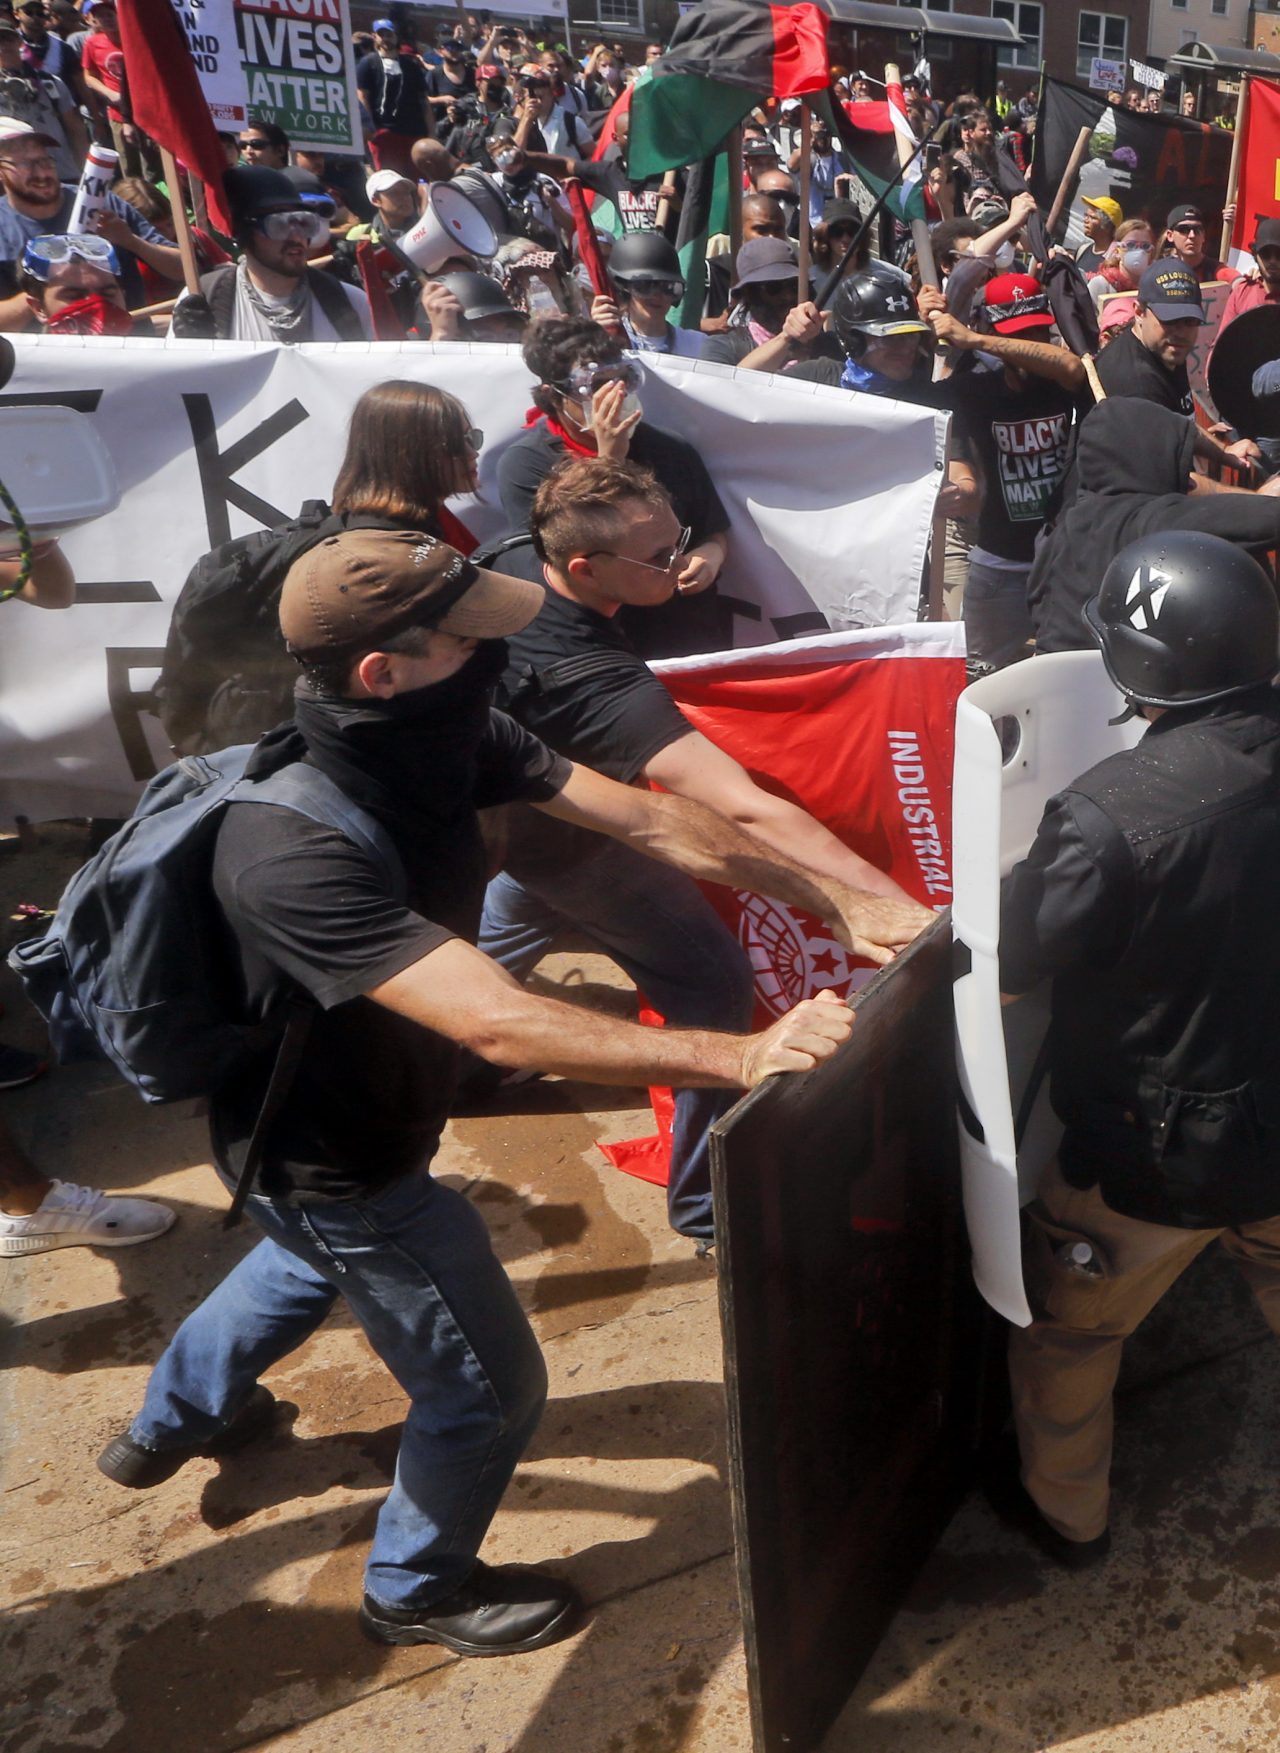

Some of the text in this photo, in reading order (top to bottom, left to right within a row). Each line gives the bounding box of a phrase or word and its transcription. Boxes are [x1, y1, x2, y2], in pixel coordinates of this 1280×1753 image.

[238, 12, 343, 74] IVES
[242, 69, 348, 115] ATTER
[247, 107, 276, 124] EW
[291, 113, 349, 132] YORK
[995, 418, 1066, 453] BLACK
[1006, 478, 1056, 505] MATT
[887, 731, 953, 895] INDUSTRIAL
